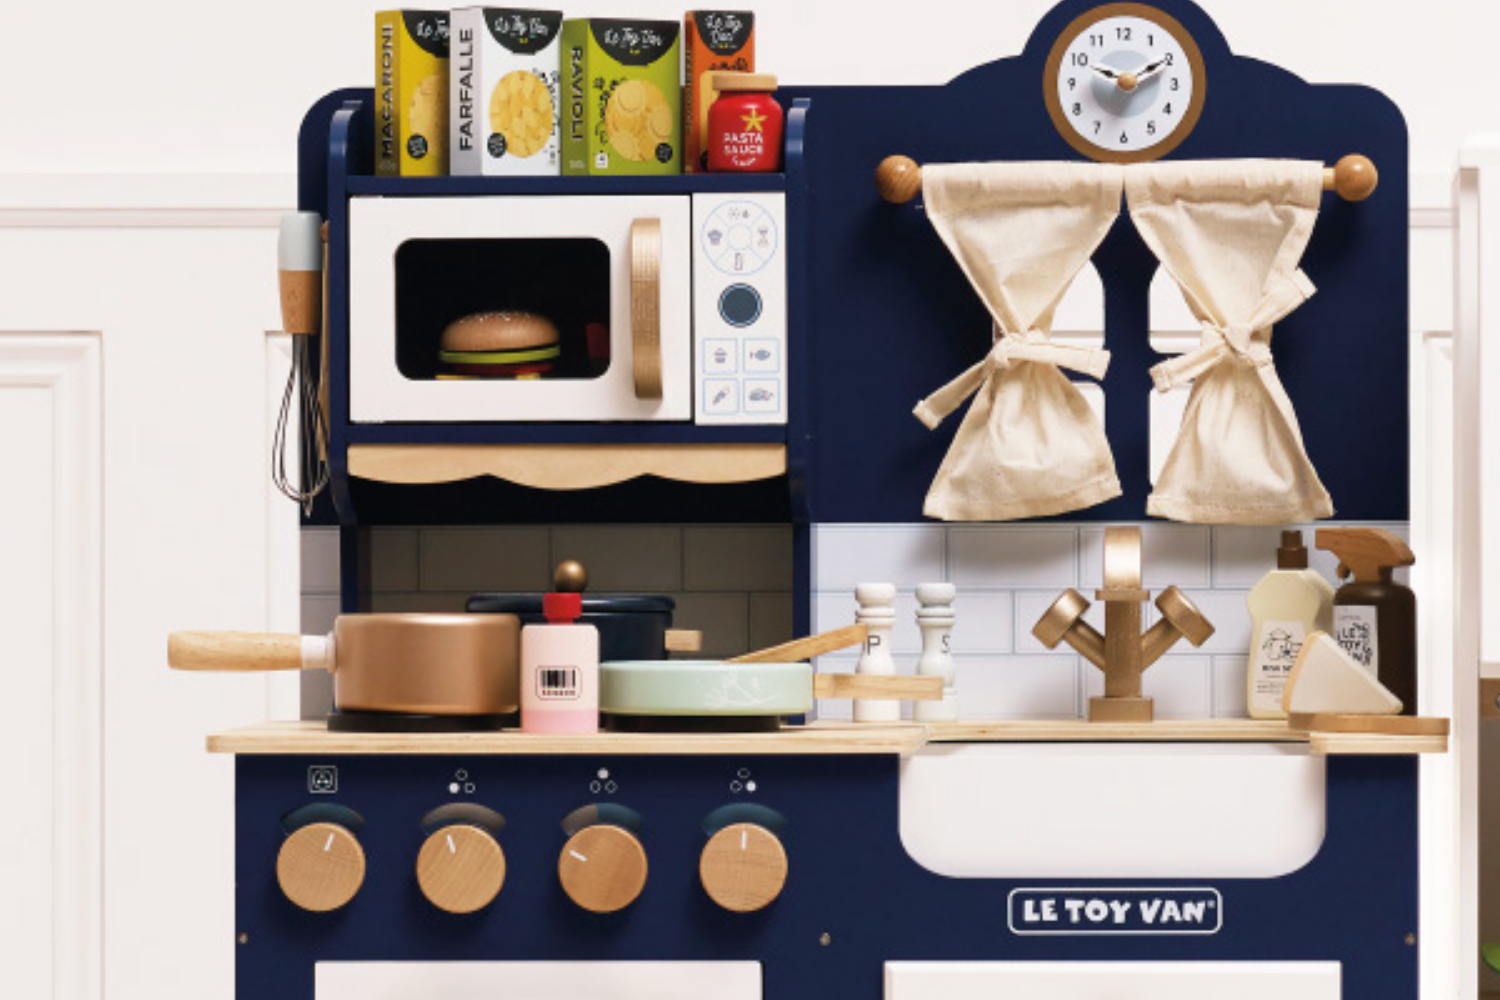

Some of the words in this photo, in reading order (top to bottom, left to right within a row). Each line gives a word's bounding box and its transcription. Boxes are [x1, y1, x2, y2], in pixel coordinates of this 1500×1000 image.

[1090, 35, 1103, 46] 11
[1115, 27, 1131, 41] 12
[1148, 35, 1153, 46] 1
[1072, 53, 1088, 66] 10
[1165, 53, 1173, 66] 2
[382, 24, 393, 158] MACARONI
[459, 28, 473, 151] FARFALLE
[1067, 78, 1076, 91] 9
[1170, 78, 1178, 91] 3
[571, 47, 583, 140] RAVIOLI
[1072, 102, 1081, 116] 8
[1162, 102, 1171, 115] 4
[1094, 121, 1101, 134] 7
[1147, 121, 1156, 134] 5
[724, 132, 763, 144] PASTA
[1119, 131, 1128, 144] 6
[724, 145, 763, 155] SAUCE
[867, 635, 881, 656] P
[941, 635, 950, 653] S
[1023, 898, 1058, 923] LE
[1064, 899, 1131, 924] TOY
